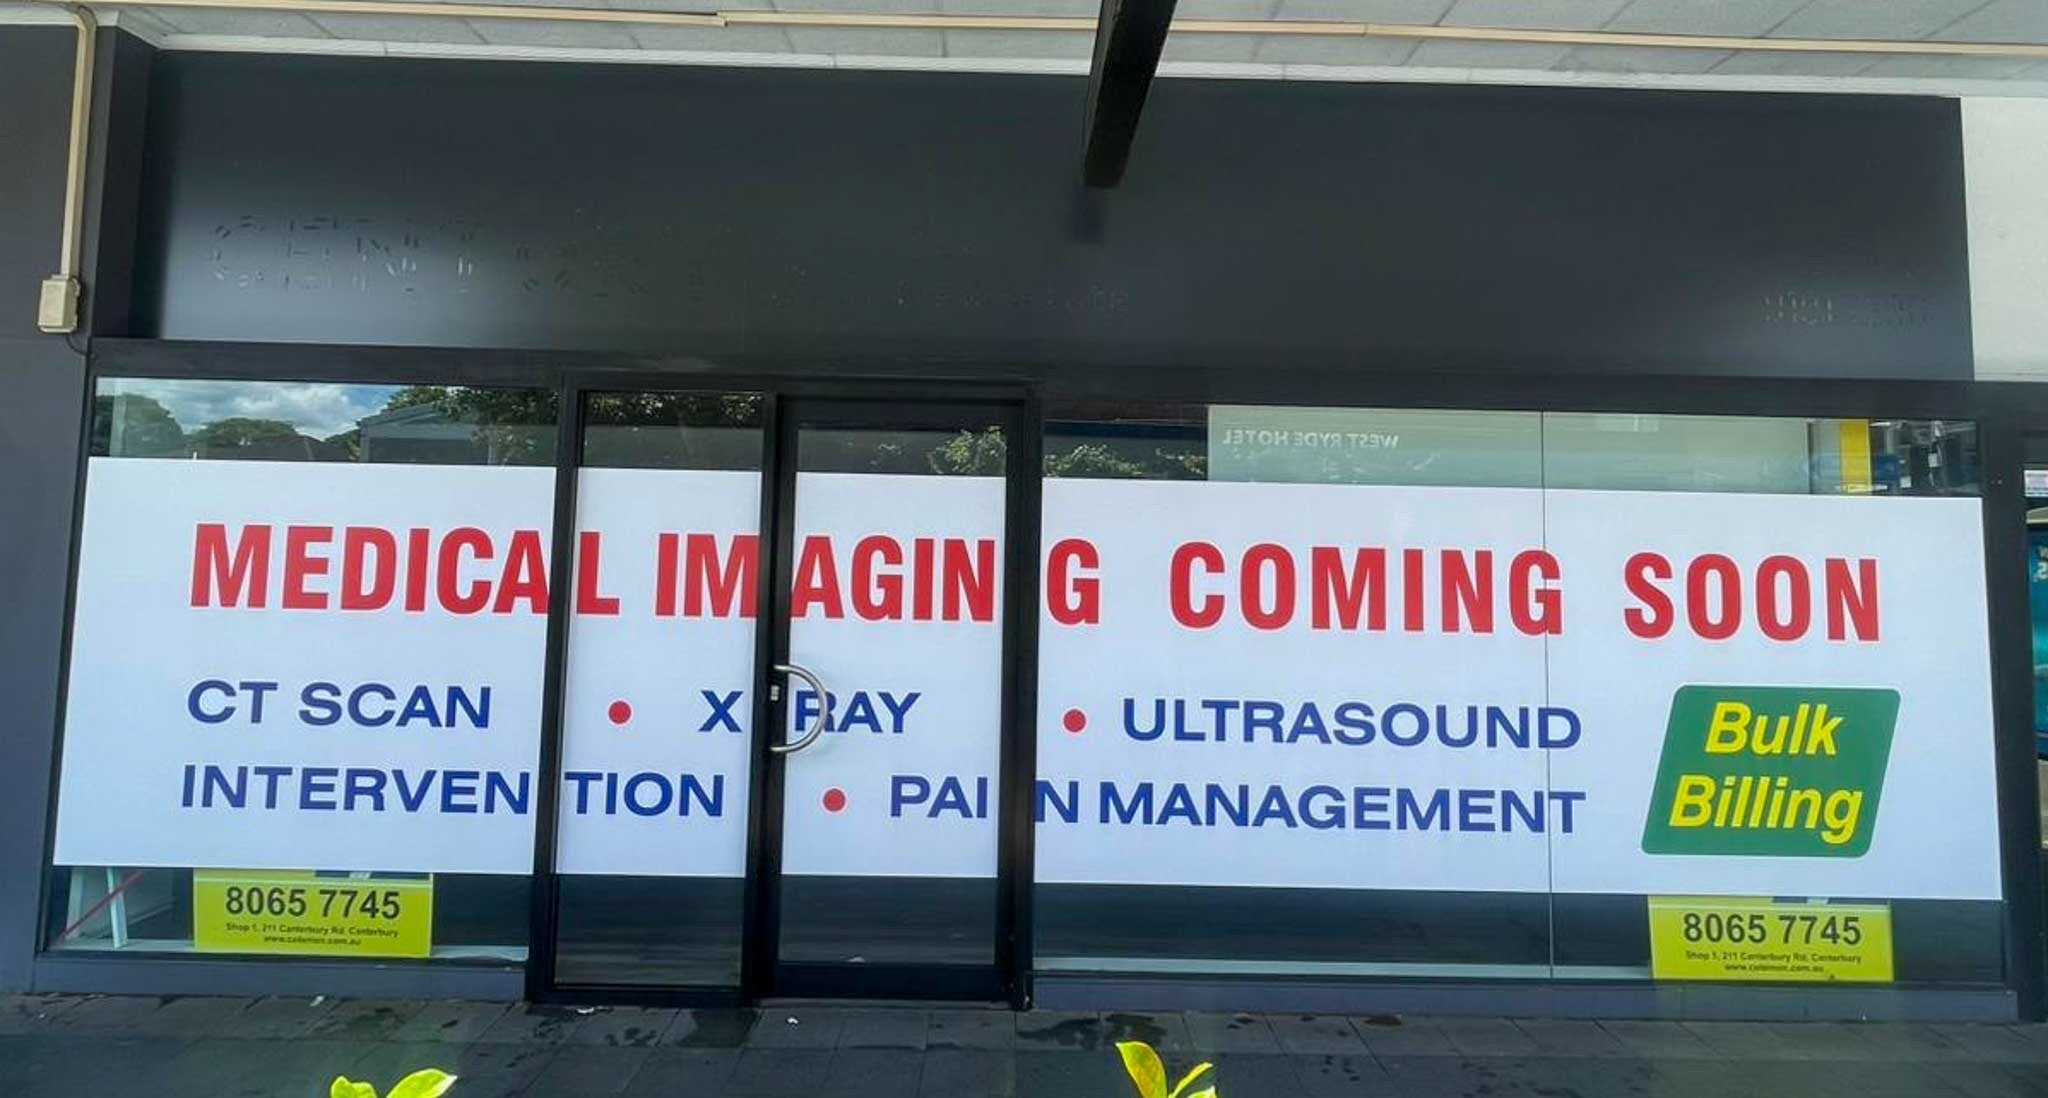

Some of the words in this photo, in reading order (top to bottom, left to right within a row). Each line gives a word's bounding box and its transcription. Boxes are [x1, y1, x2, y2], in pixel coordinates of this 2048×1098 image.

[189, 523, 620, 616] MEDICAL
[655, 533, 1101, 626] IMAGING
[1170, 543, 1563, 636] COMING
[1624, 552, 1879, 642] SOON
[187, 680, 278, 724] CT
[299, 682, 491, 729] SCAN
[1123, 698, 1582, 750] ULTRASOUND
[1705, 701, 1843, 755] Bulk
[182, 764, 724, 817] INTERVENTION
[889, 775, 1079, 824] PAIN
[1099, 781, 1586, 834] MANAGEMENT
[1668, 775, 1863, 844] Billing
[225, 886, 307, 917] 8065
[319, 889, 401, 919] 7745
[279, 924, 329, 936] Canterbury
[348, 926, 399, 938] Canterbury
[1683, 913, 1767, 944] 8065
[1778, 914, 1862, 945] 7745
